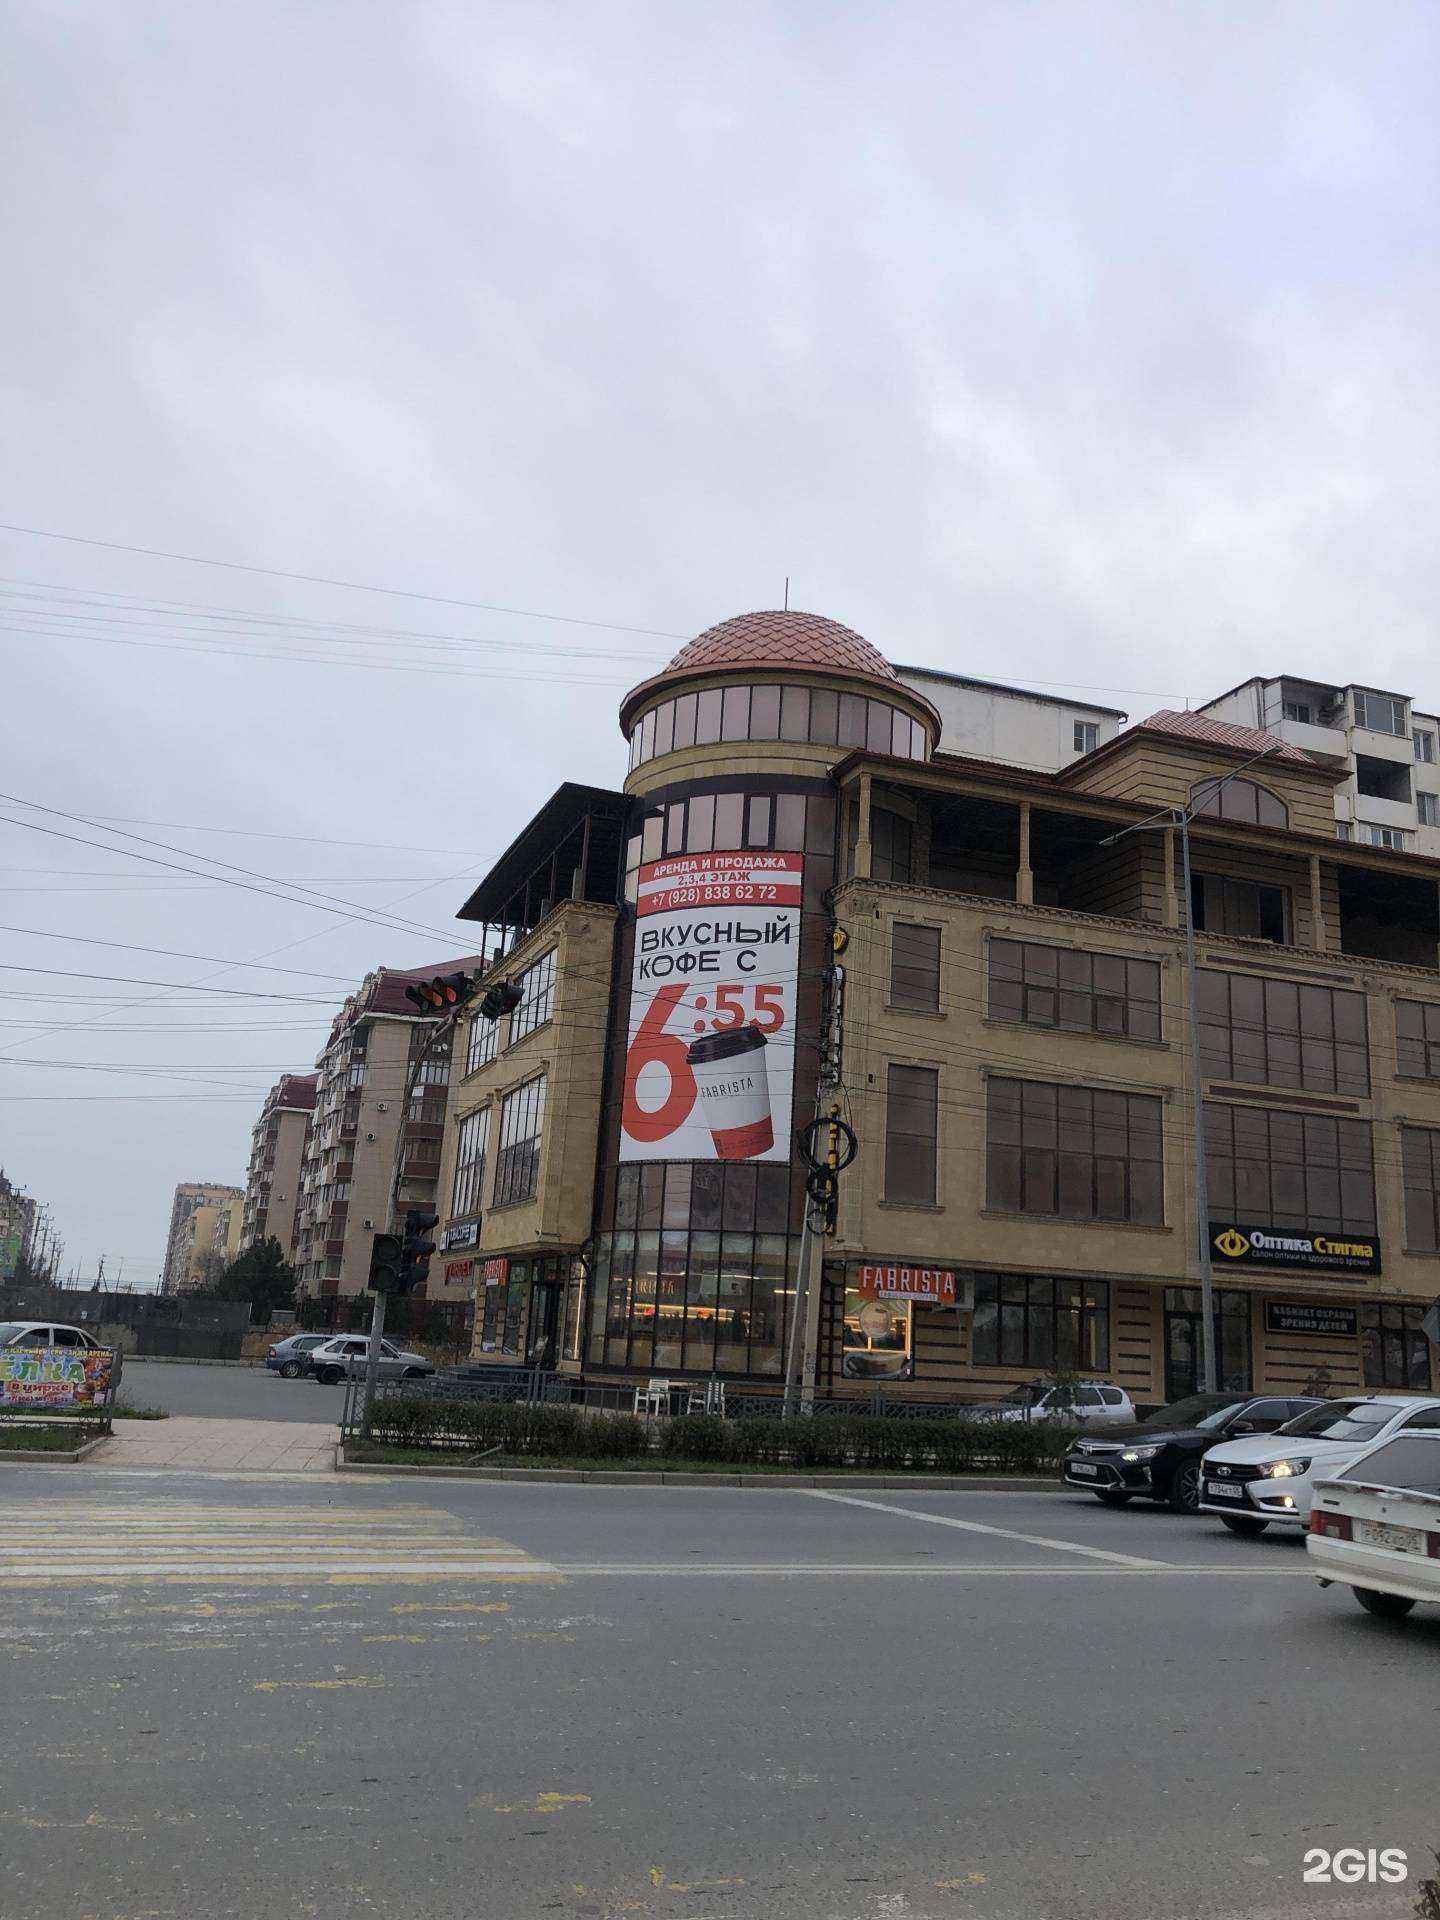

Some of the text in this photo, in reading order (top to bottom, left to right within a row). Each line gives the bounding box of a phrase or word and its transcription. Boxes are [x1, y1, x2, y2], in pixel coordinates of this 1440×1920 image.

[653, 857, 787, 878] АРЕНДА И ПРОДАЖА
[678, 872, 751, 886] 2,3,4 ЭТАЖ
[652, 886, 777, 906] +7 (928) 838 62 72
[641, 915, 790, 953] ВКУСНЫЙ
[640, 950, 757, 980] КОФЕ С
[701, 1077, 754, 1098] FABRISTA
[1250, 1231, 1373, 1258] Оптика Стигма
[863, 1266, 955, 1295] FABRISTA
